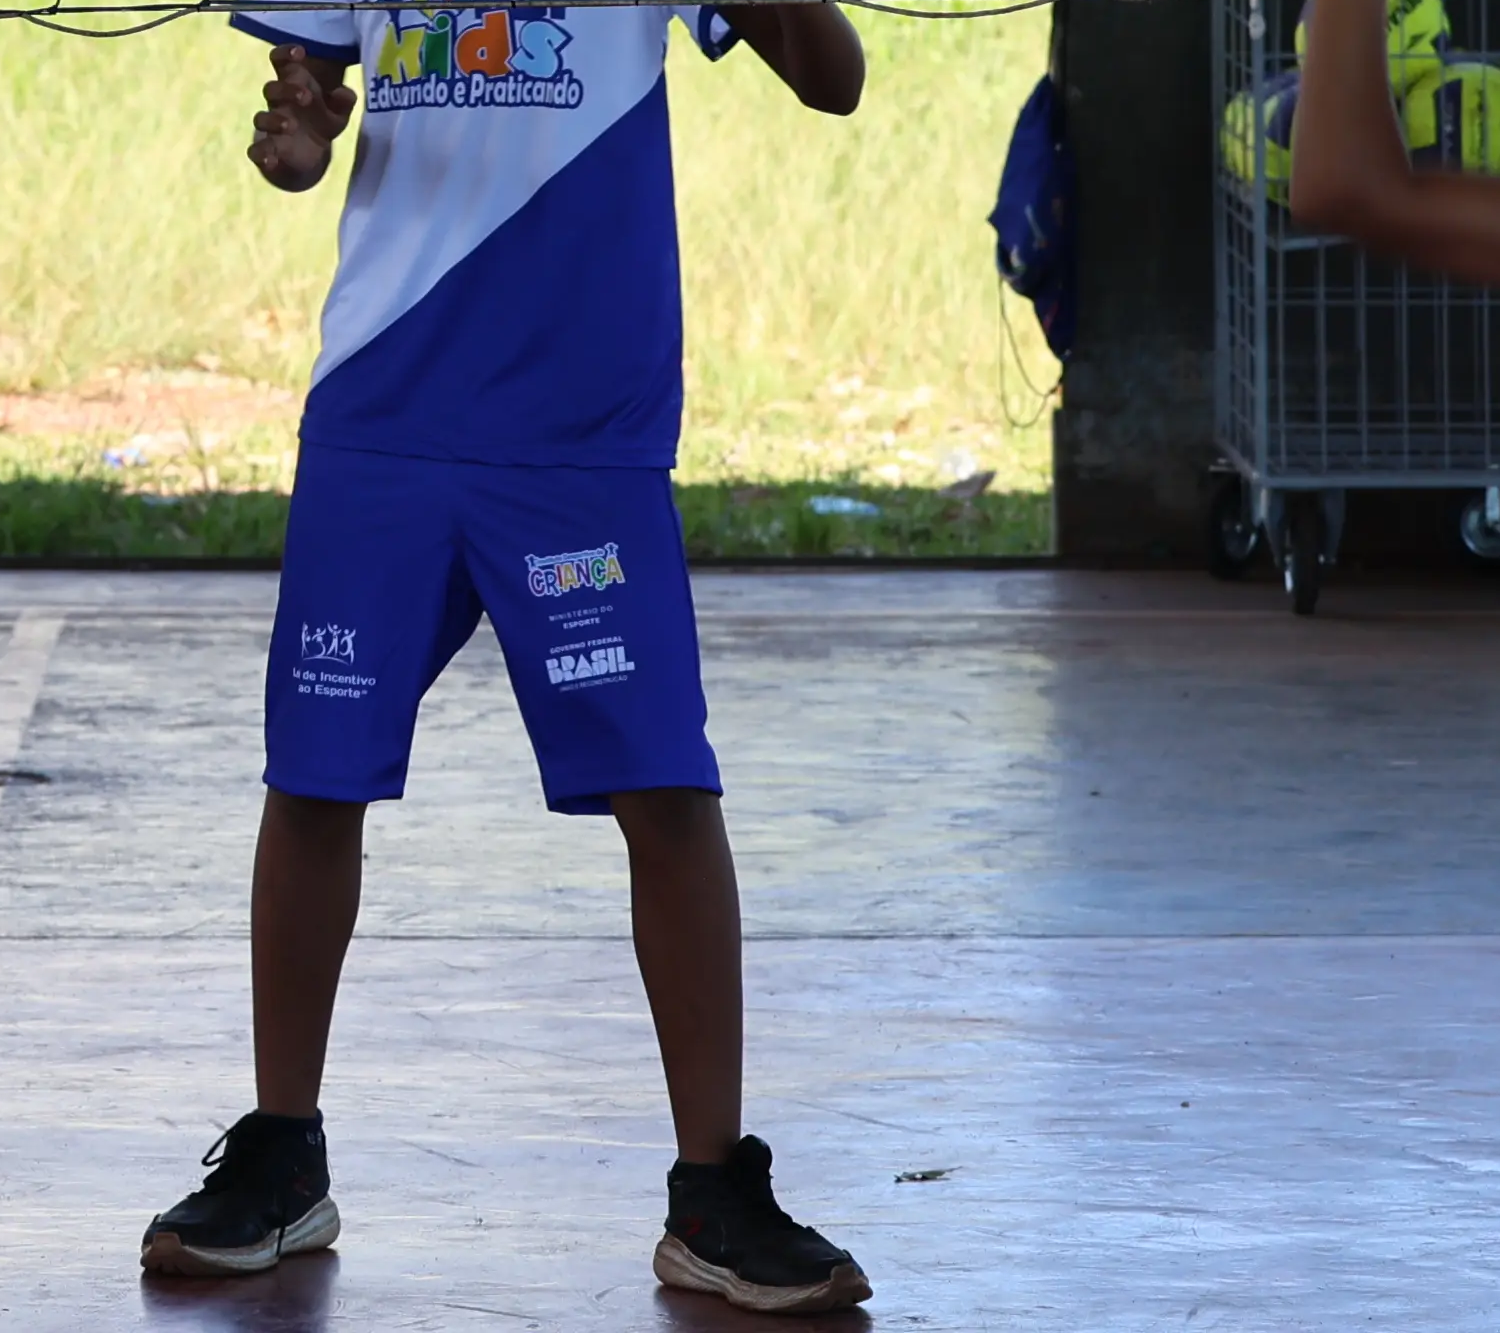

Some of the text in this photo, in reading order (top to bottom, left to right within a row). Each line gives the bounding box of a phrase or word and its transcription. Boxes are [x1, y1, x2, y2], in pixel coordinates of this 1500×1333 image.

[453, 81, 467, 105] e
[528, 555, 626, 597] CRIANÇA
[563, 617, 600, 630] ESPORTE
[550, 636, 624, 654] GOVERNO FEDERAL
[545, 645, 636, 685] BRASIL
[303, 670, 316, 681] de
[320, 671, 376, 686] Incentivo
[298, 684, 311, 693] ao
